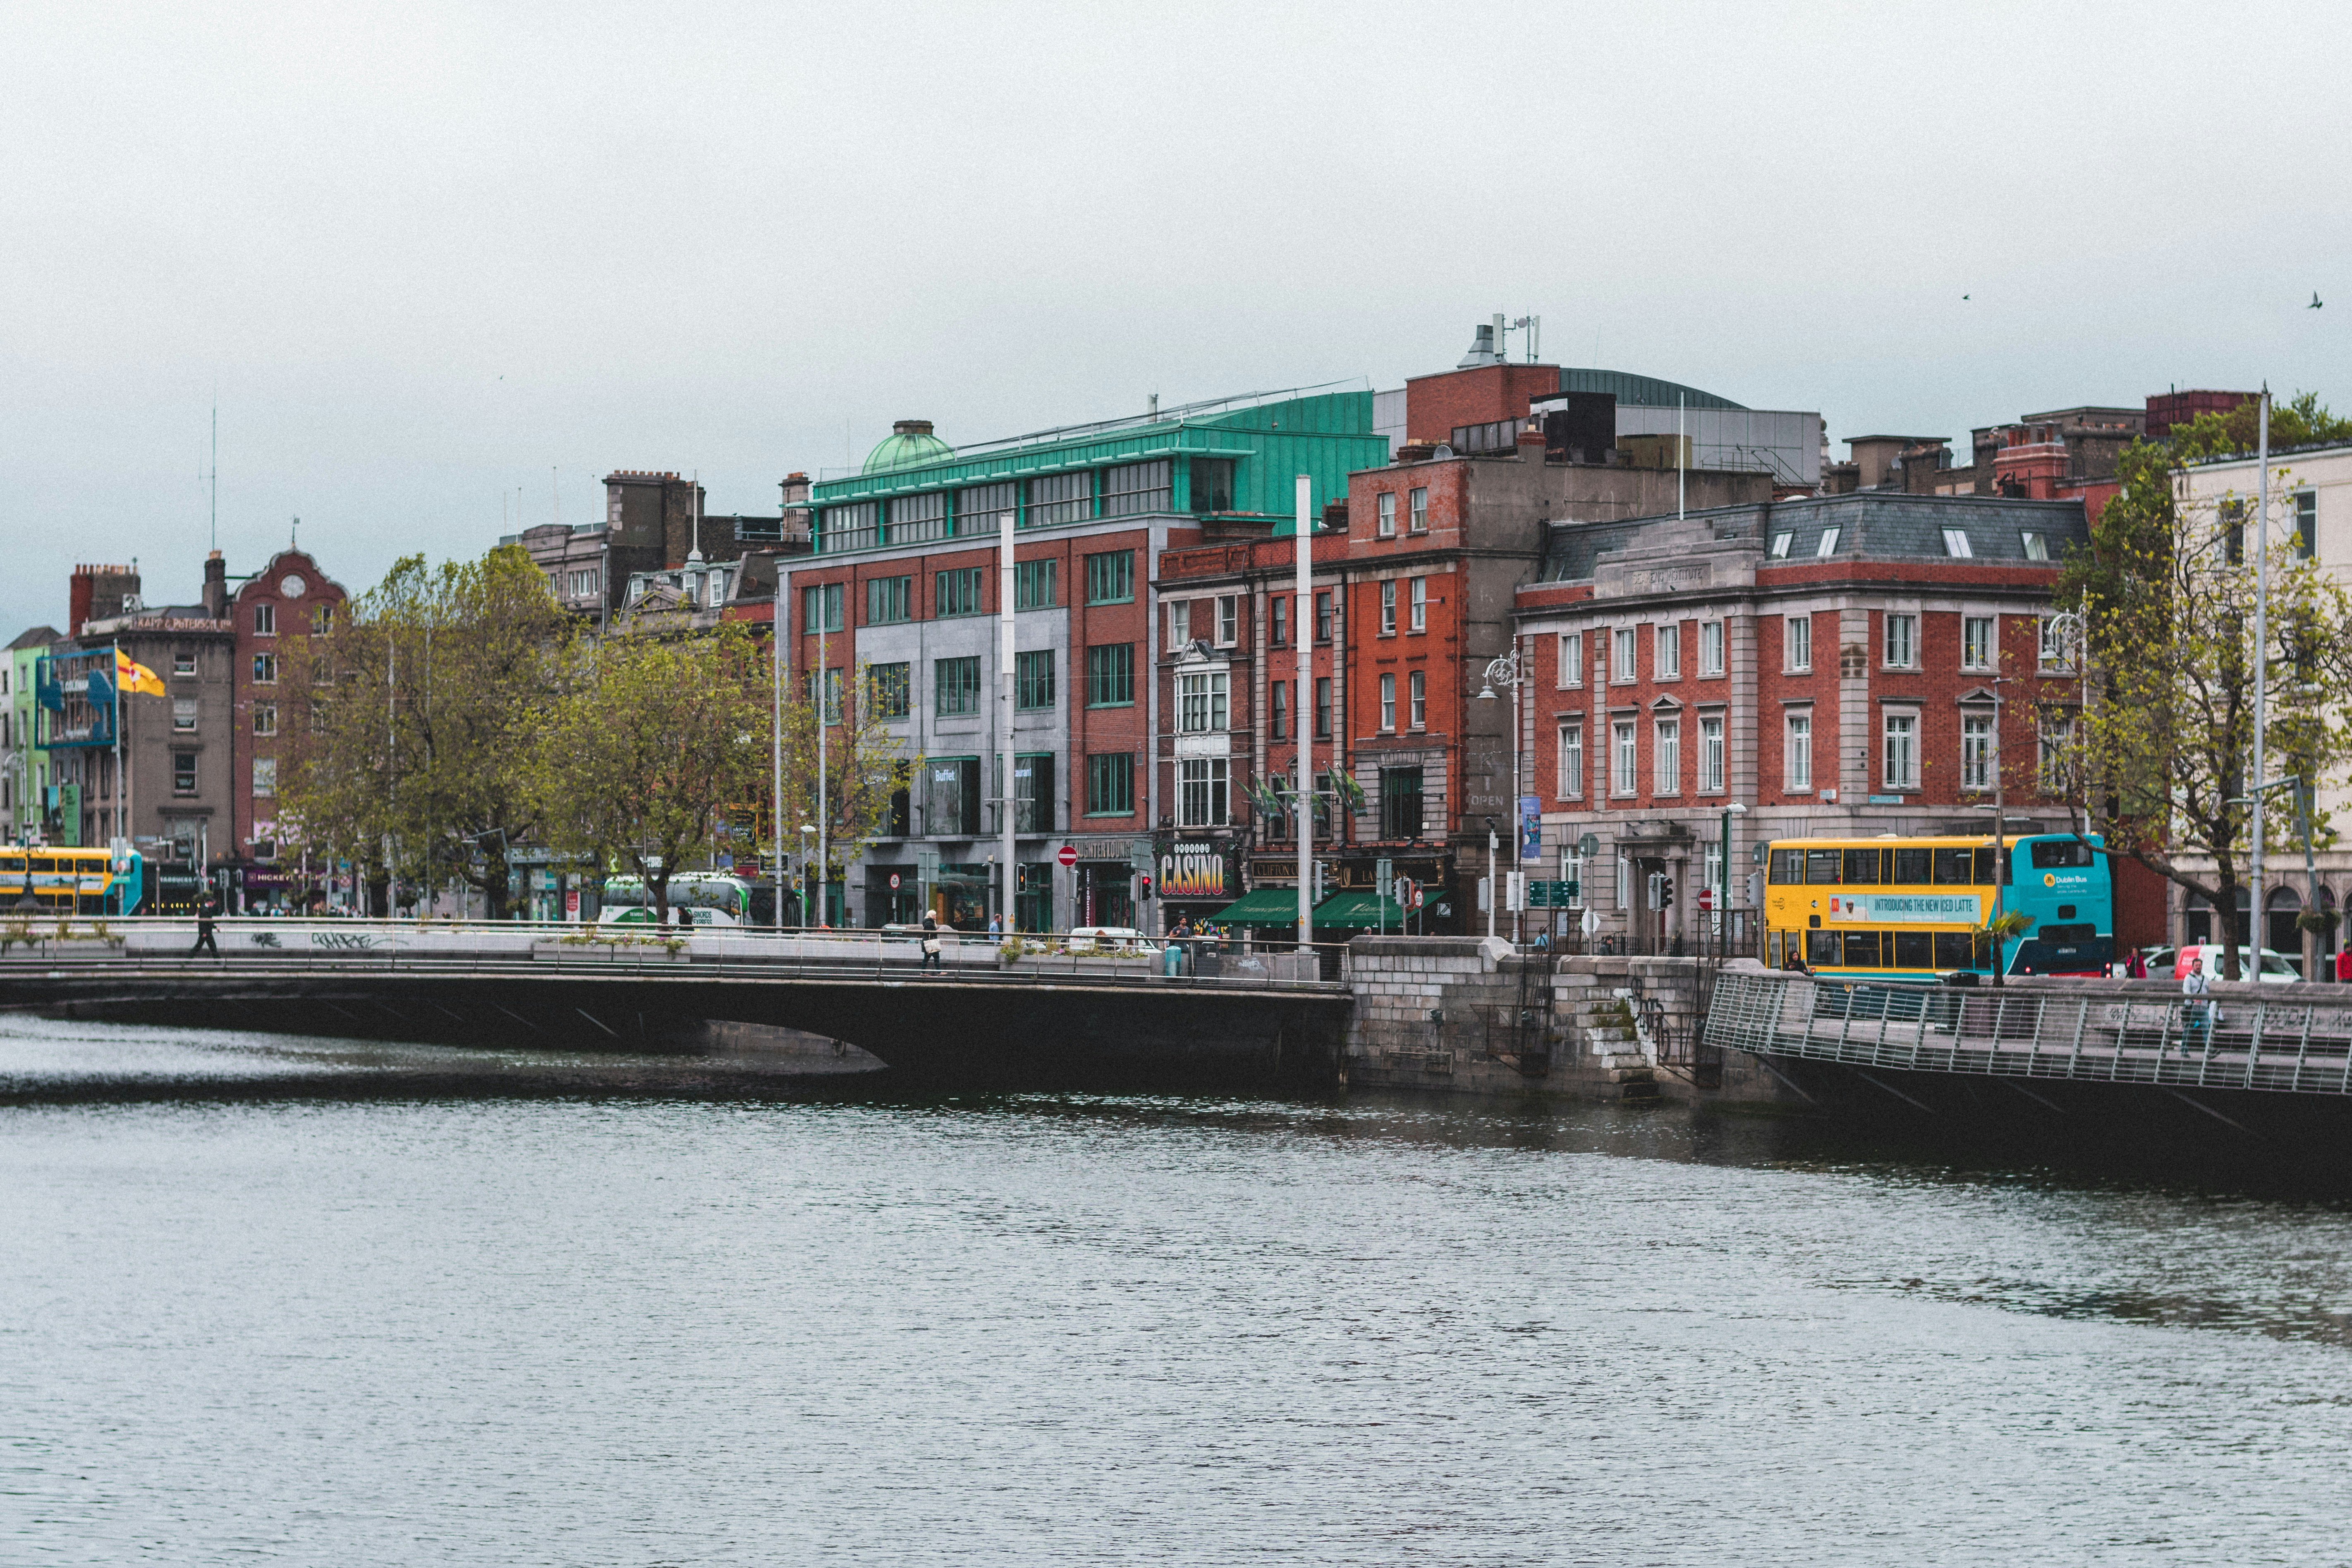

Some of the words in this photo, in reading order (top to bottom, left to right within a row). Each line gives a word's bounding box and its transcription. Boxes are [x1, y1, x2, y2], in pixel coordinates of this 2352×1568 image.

[1633, 571, 1664, 584] SEAMENS
[1667, 567, 1702, 581] INSTITUTE
[935, 769, 955, 781] Buffet
[1014, 768, 1031, 777] aurant
[1471, 796, 1503, 806] OPEN
[1071, 842, 1105, 858] AUGHTER
[1175, 844, 1210, 853] EMERALD
[1161, 854, 1223, 895] CASINO
[1258, 864, 1289, 876] CLIFTON
[1875, 898, 1912, 911] INTRODUCING
[1914, 899, 1924, 911] THE
[1925, 899, 1939, 911] NEW
[1940, 899, 1953, 912] ICED
[1955, 899, 1972, 912] LATTE
